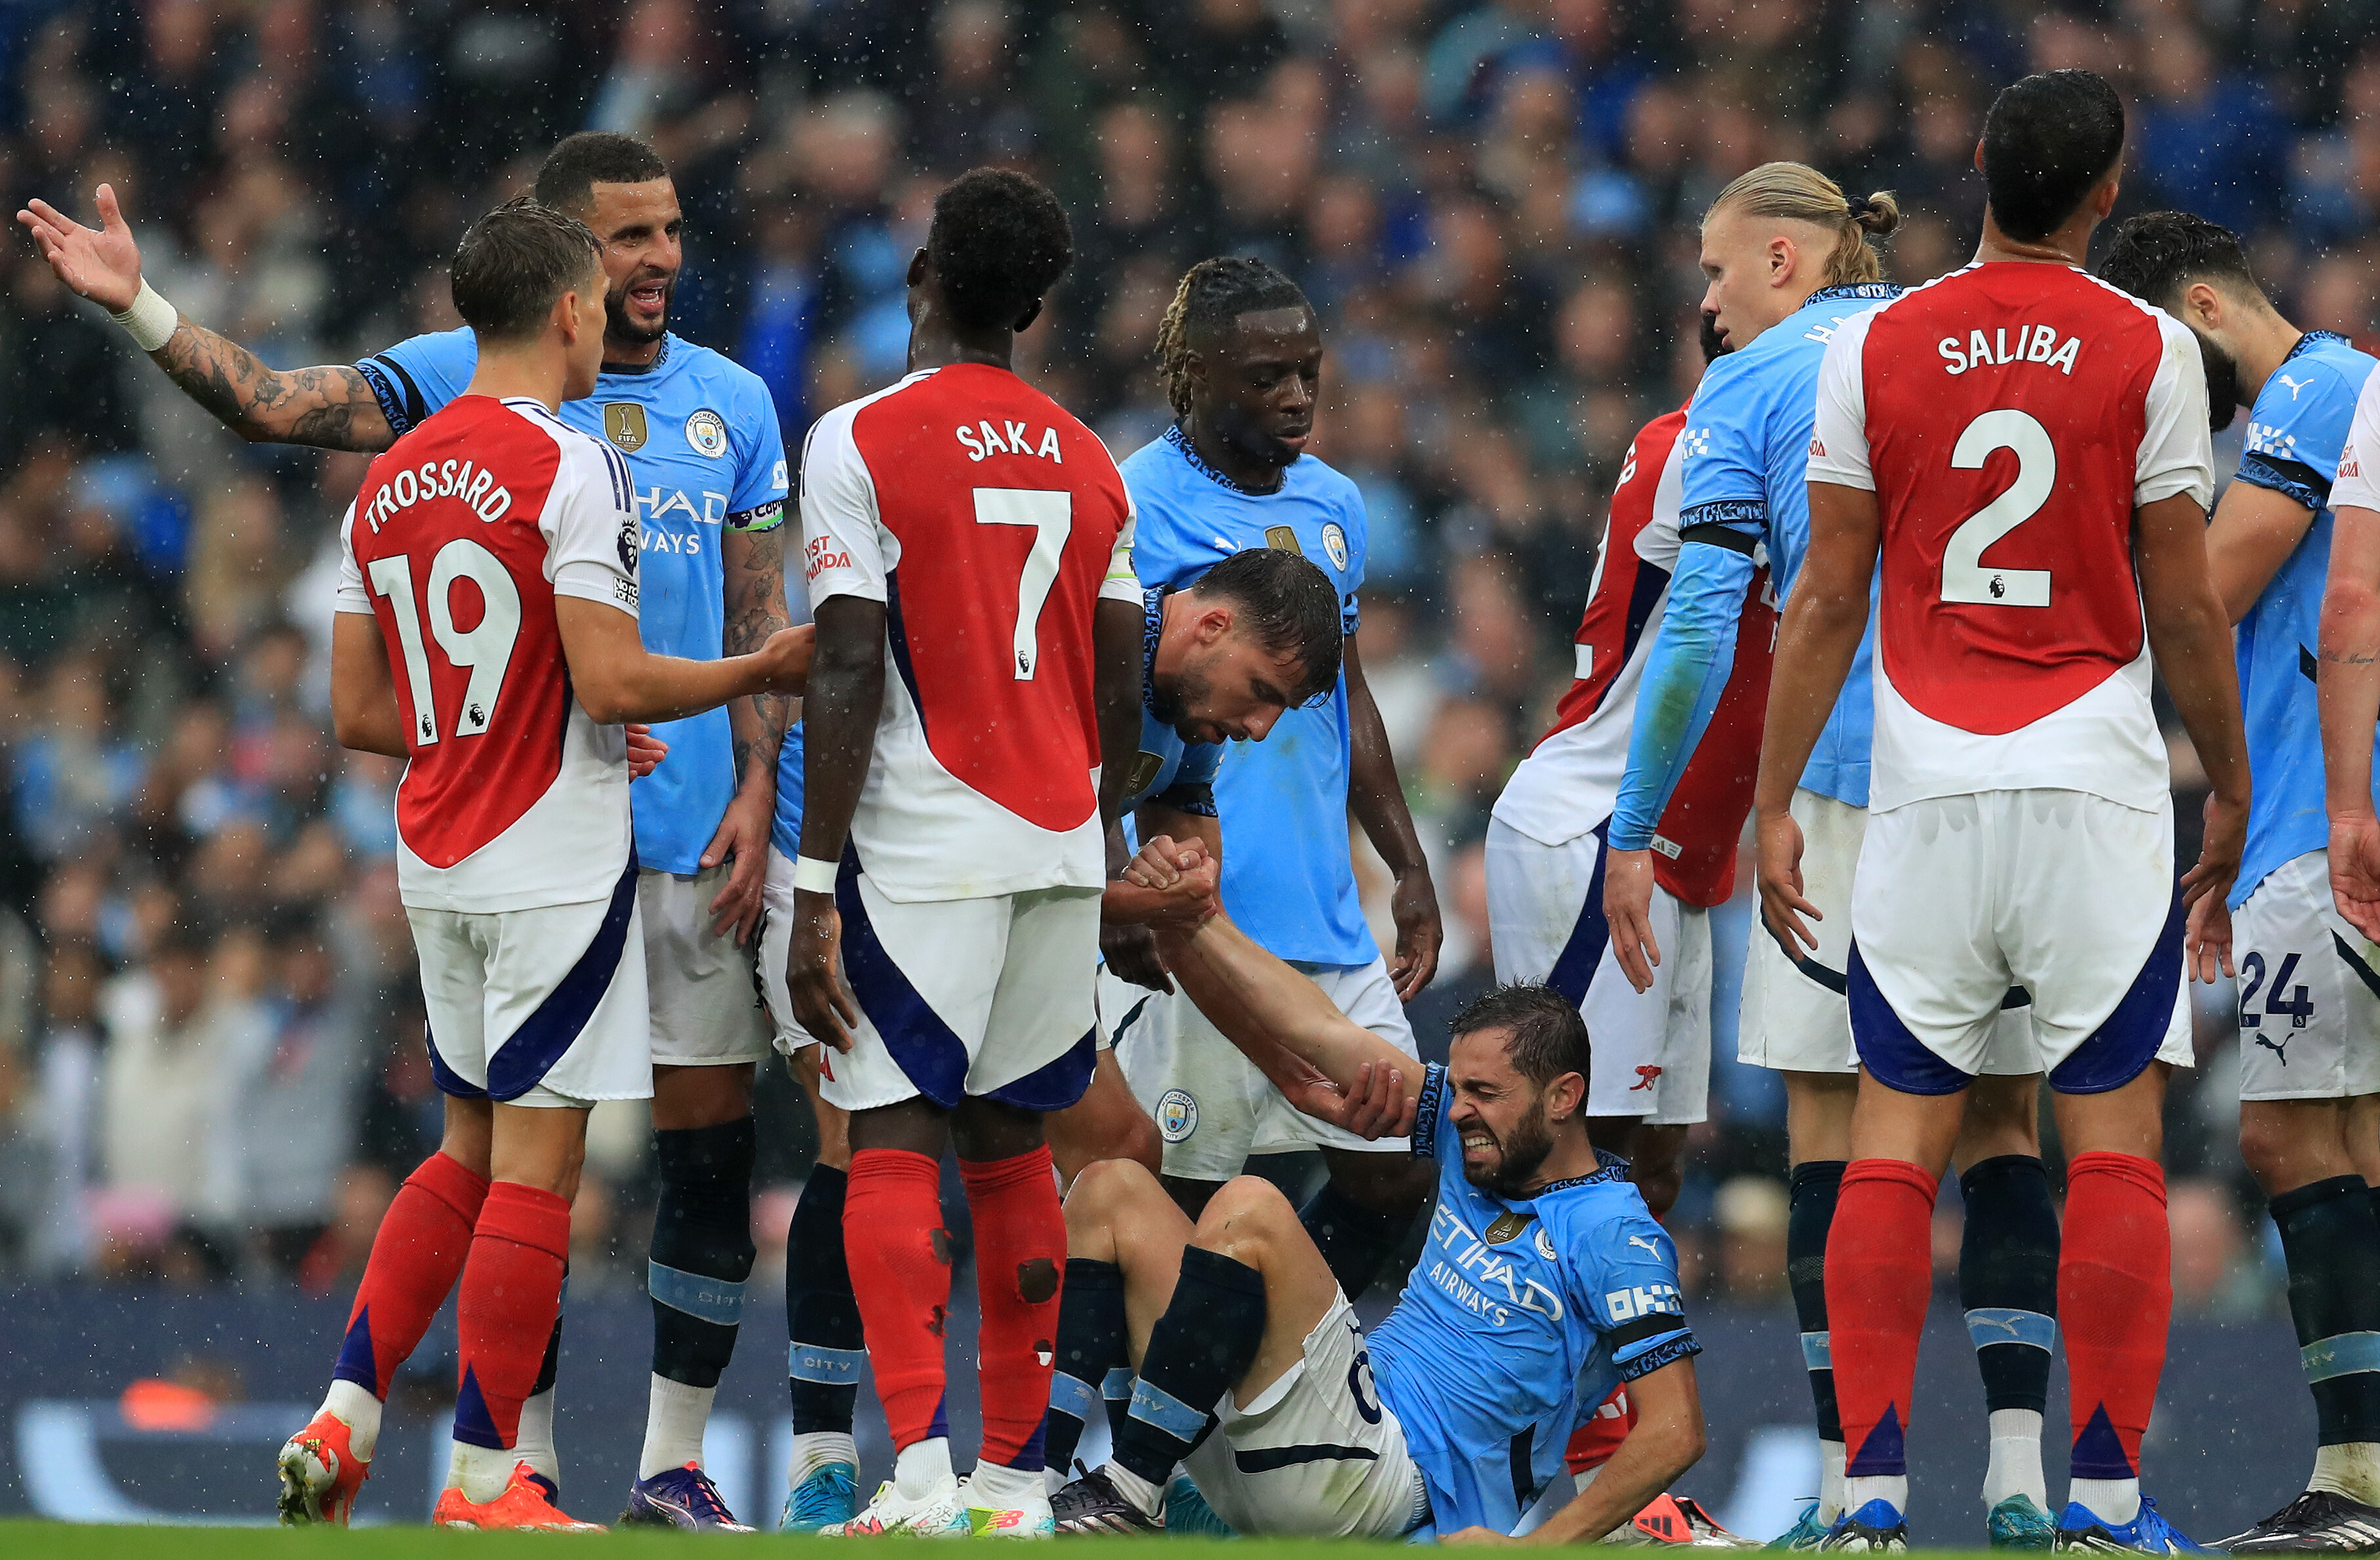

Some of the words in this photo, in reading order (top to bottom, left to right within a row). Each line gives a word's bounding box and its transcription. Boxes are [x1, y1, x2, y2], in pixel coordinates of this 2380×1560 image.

[1939, 324, 2082, 375] SALIBA
[689, 413, 722, 430] MANCHESTER
[956, 420, 1062, 464] SAKA
[365, 459, 512, 534] TROSSARD
[636, 487, 728, 525] HAD
[1940, 408, 2057, 607] 2
[614, 577, 628, 592] No
[628, 585, 638, 597] ro
[614, 586, 628, 601] for
[972, 487, 1072, 680] 7
[367, 538, 522, 747] 19
[2240, 951, 2314, 1028] 24
[1162, 1093, 1194, 1111] MANCHESTER
[1433, 1203, 1563, 1321] ETIHAD
[1540, 1248, 1553, 1258] CITY
[1429, 1261, 1509, 1327] AIRWAYS
[804, 1357, 851, 1372] CITY
